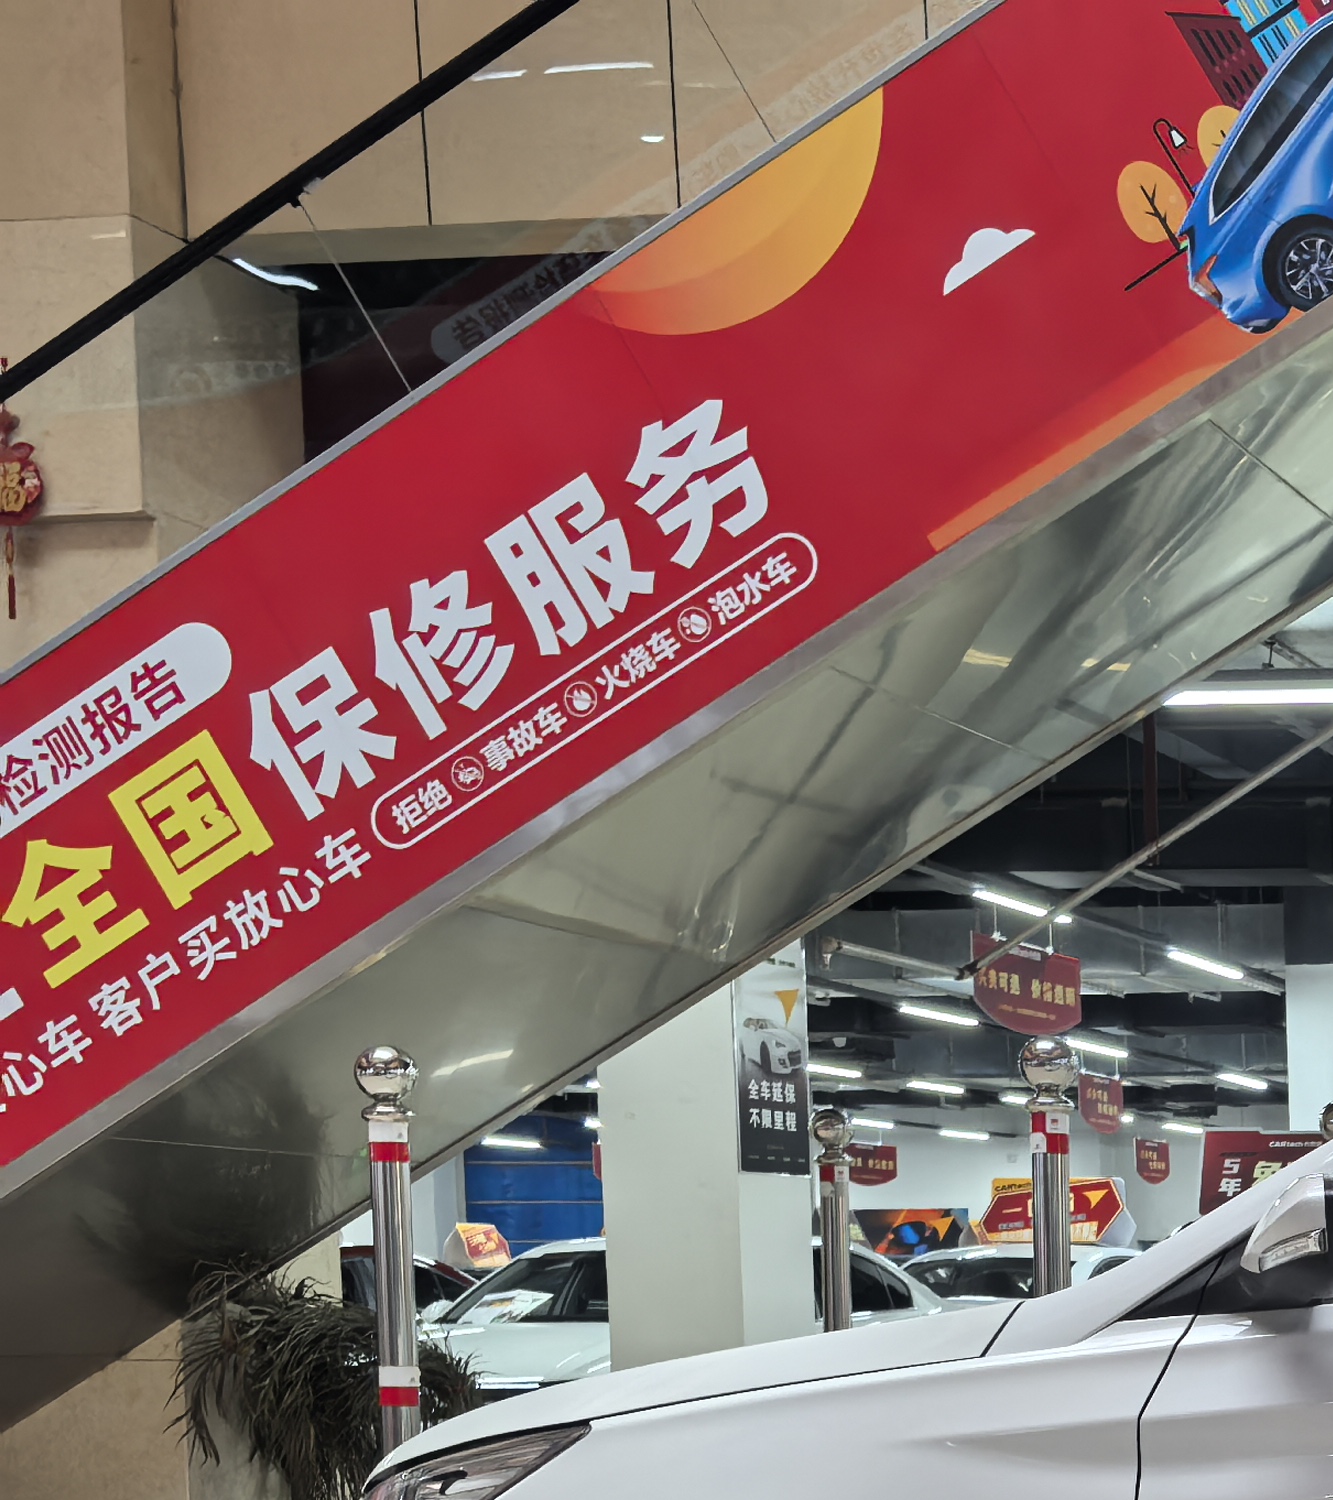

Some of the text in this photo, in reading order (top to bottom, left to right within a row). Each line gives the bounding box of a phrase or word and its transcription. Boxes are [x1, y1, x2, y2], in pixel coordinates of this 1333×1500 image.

[0, 399, 769, 1021] 全国保修服务
[391, 552, 798, 834] 拒绝 事故车 火烧车 泡水车
[0, 828, 372, 1112] 心车 客户买放心车
[748, 1079, 797, 1104] 全车延保
[749, 1108, 797, 1132] 不限里程
